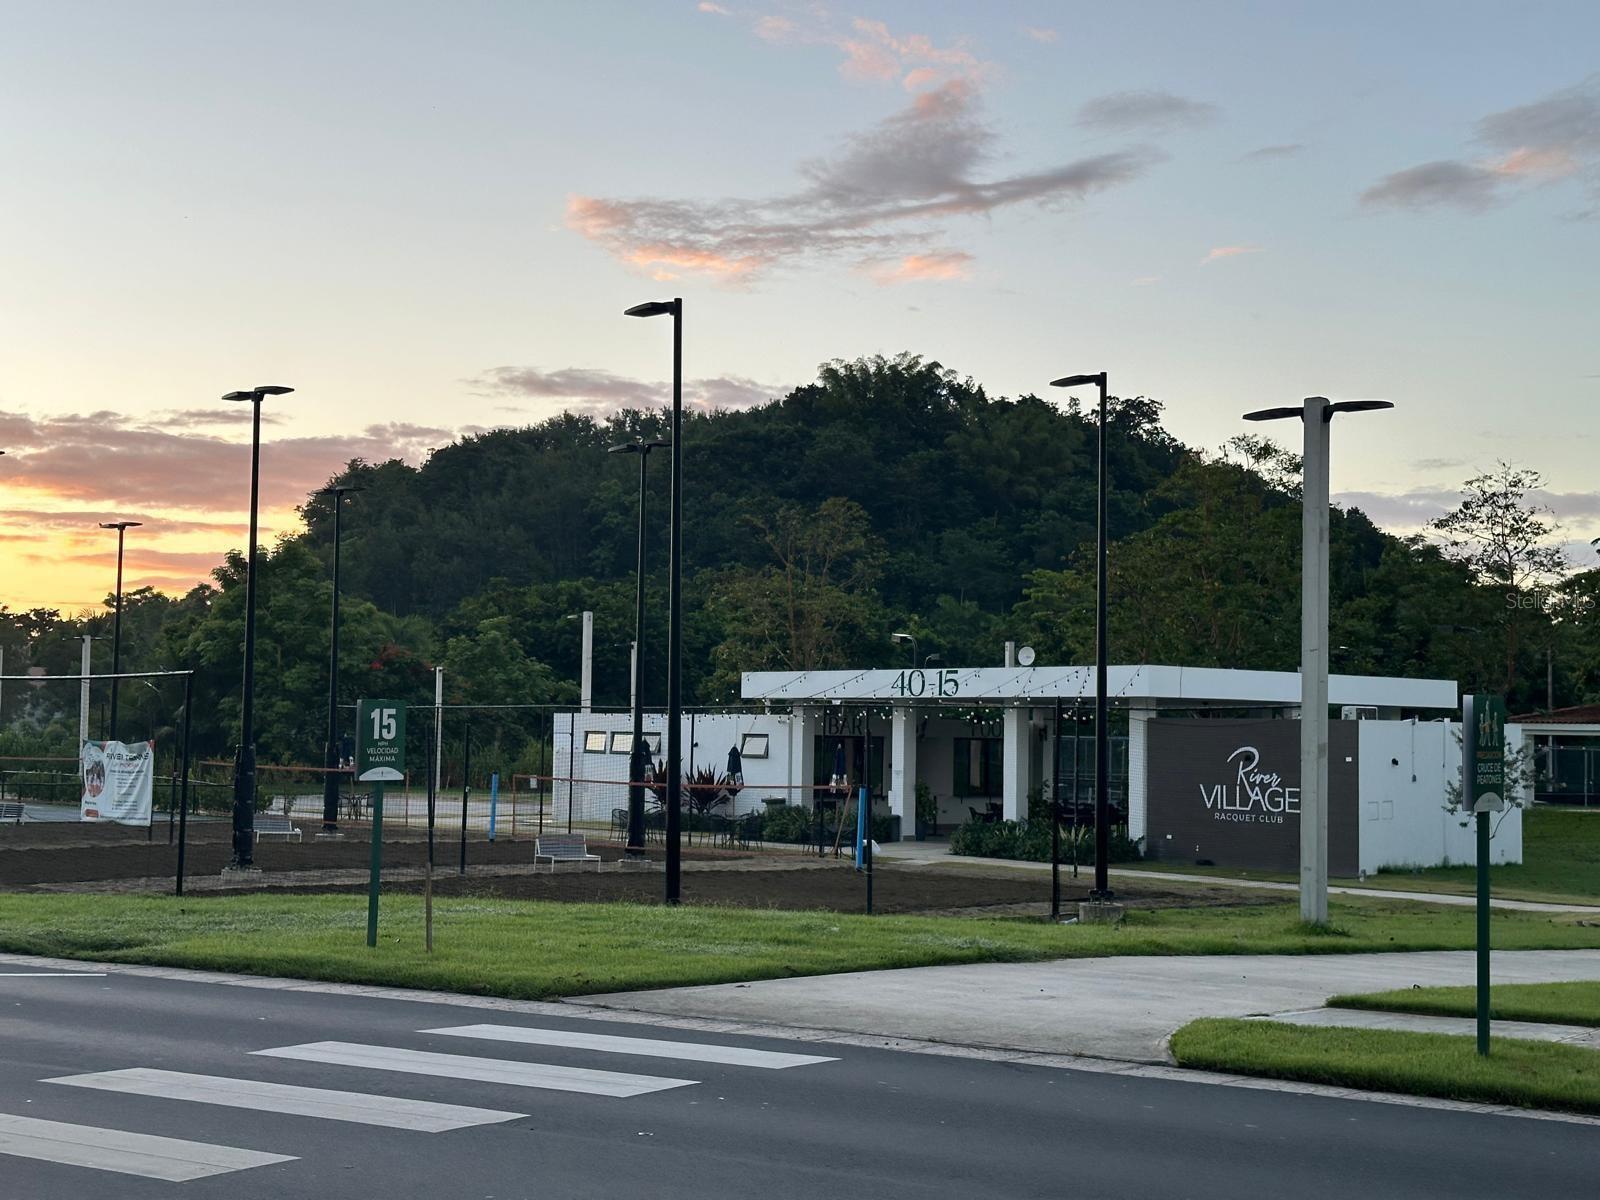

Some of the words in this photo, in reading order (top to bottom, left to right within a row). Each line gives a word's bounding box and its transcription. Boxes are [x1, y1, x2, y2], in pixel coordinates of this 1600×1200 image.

[891, 669, 959, 697] 40-15
[370, 708, 396, 740] 15
[828, 716, 863, 735] BAR
[367, 747, 399, 755] VELOCIDAD
[1227, 746, 1281, 787] River
[1200, 783, 1300, 813] VILLAGE
[1214, 812, 1256, 822] RACQUET
[1259, 815, 1284, 824] CLUB
